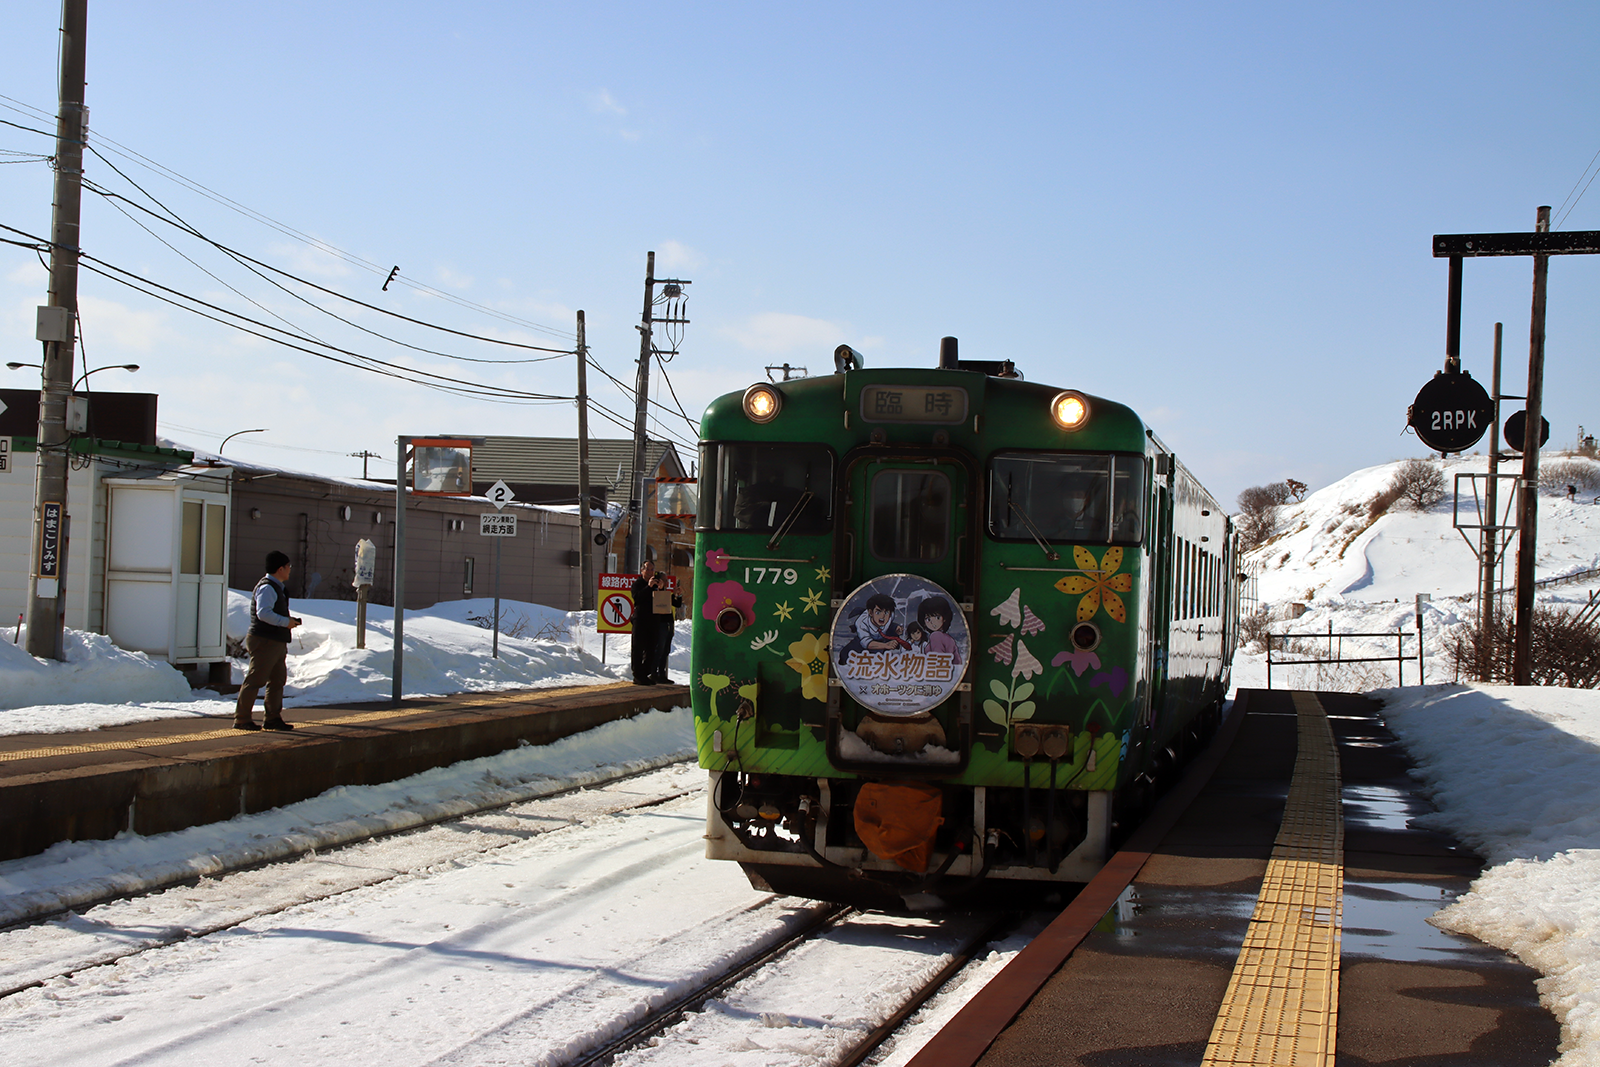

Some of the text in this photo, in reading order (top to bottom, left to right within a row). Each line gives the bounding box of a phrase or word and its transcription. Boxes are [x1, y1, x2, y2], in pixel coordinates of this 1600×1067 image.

[1431, 409, 1477, 431] 2RPK
[495, 487, 505, 502] 2
[43, 507, 58, 571] はまこしみず
[482, 524, 515, 535] 網走方面
[744, 567, 798, 586] 1779
[847, 651, 953, 680] 流氷物語
